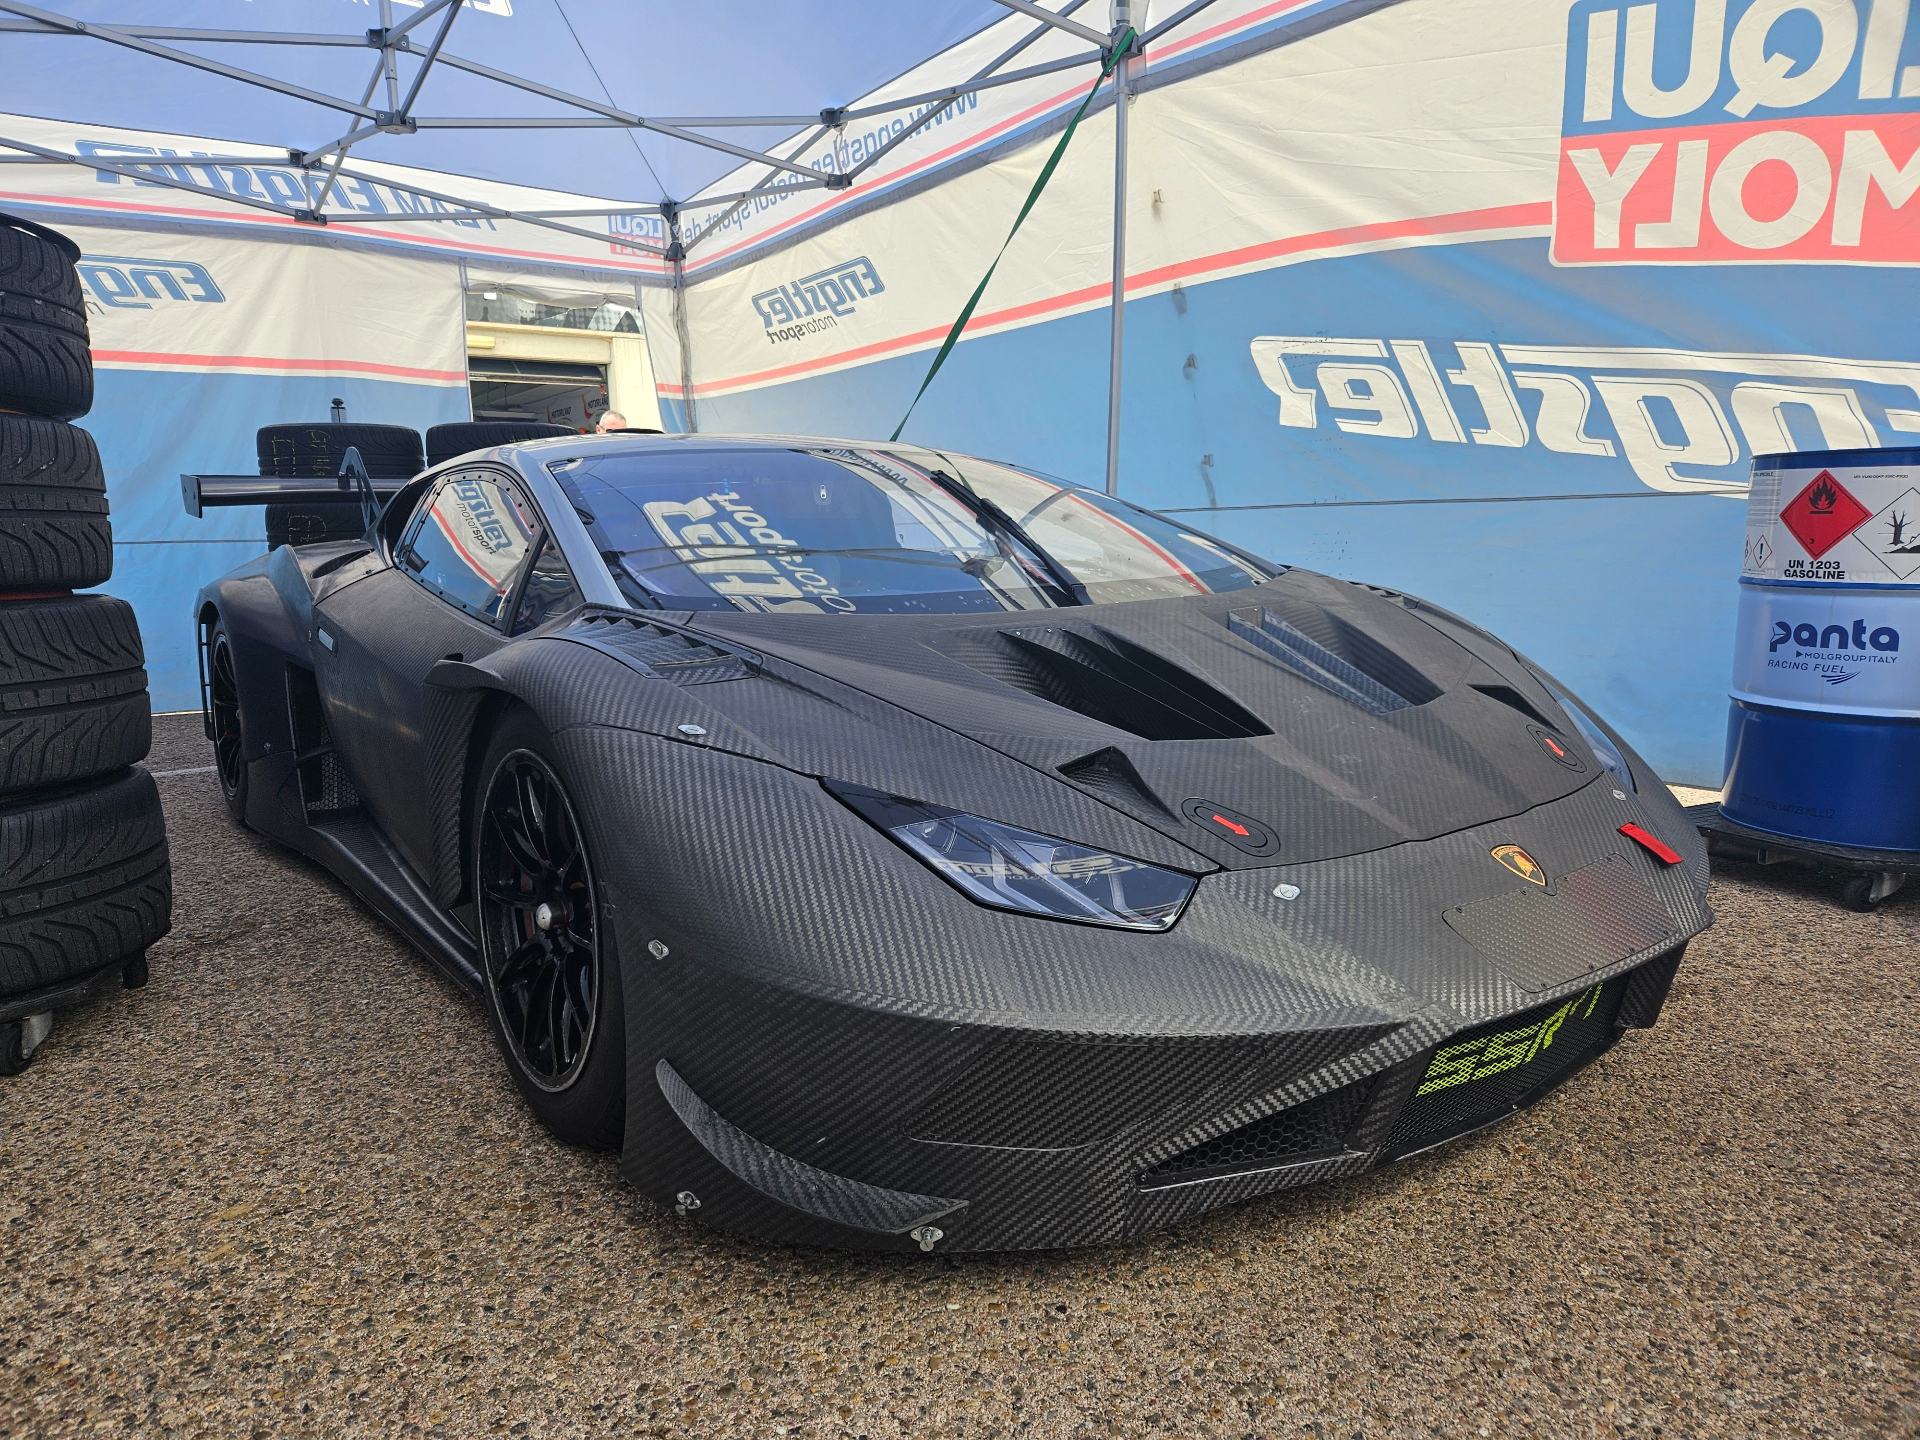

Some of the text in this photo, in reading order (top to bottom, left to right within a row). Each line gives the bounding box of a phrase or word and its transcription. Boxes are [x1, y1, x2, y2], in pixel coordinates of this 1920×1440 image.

[1788, 559, 1841, 570] UN 1203
[1783, 569, 1846, 580] GASOLINE
[1769, 618, 1900, 653] panta
[1767, 659, 1847, 674] RACING FUEL
